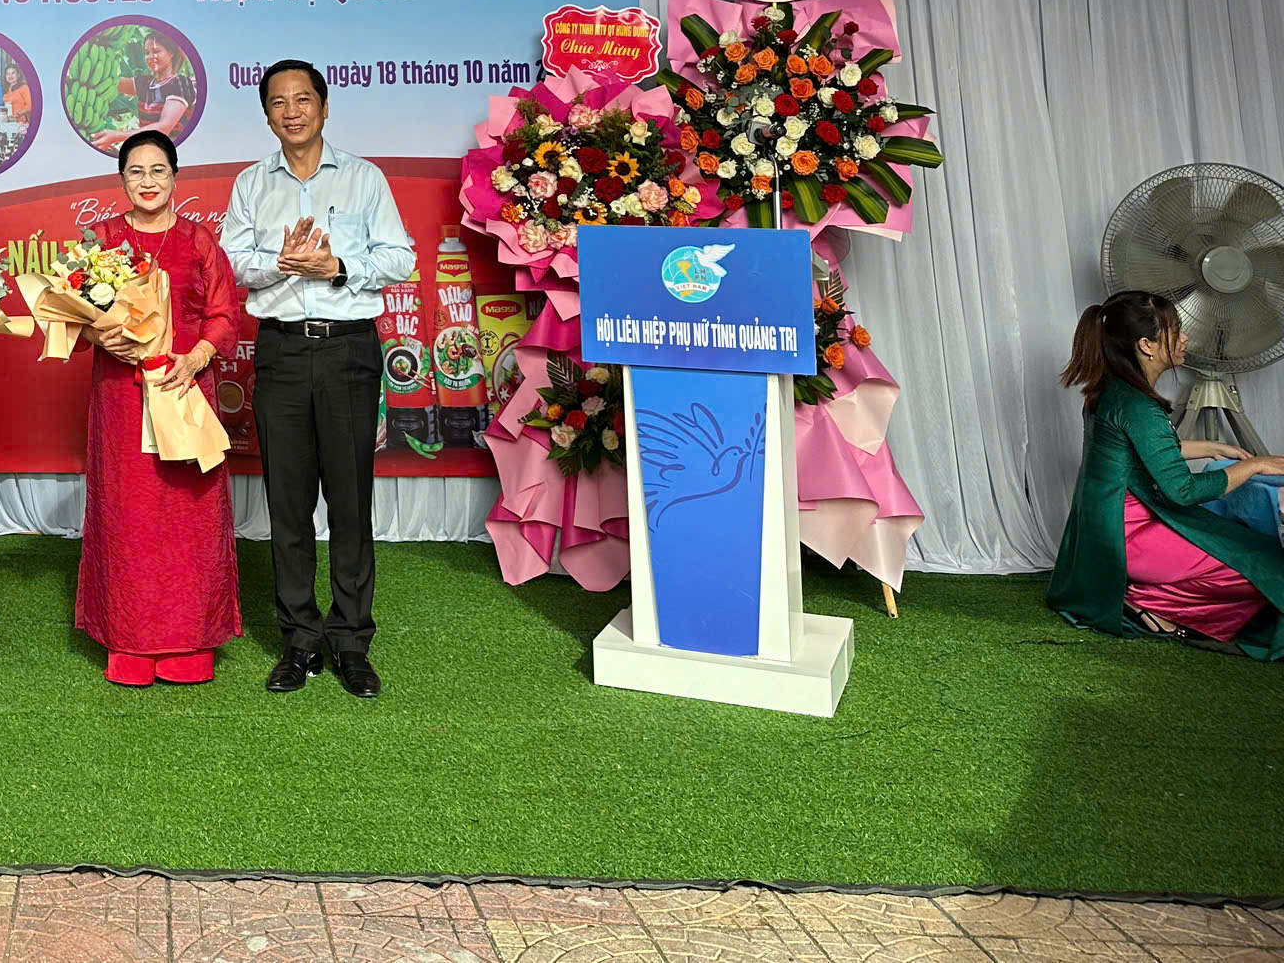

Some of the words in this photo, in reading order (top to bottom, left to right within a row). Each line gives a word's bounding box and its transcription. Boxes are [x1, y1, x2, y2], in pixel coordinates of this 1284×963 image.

[560, 38, 595, 54] Chúc
[597, 40, 641, 61] Mừng
[229, 61, 270, 89] Quả
[326, 60, 372, 88] ngày
[376, 60, 397, 85] 18
[402, 59, 459, 87] tháng
[463, 59, 483, 84] 10
[488, 59, 531, 83] năm
[7, 228, 58, 277] NẤU
[439, 263, 468, 271] Maggi
[448, 302, 473, 324] HÀO
[485, 305, 517, 314] Maggi
[596, 312, 615, 347] HỘI
[616, 313, 641, 344] LIÊN
[642, 315, 667, 350] HIỆP
[669, 320, 691, 352] PHỤ
[693, 317, 710, 348] NỮ
[711, 315, 737, 349] TỈNH
[738, 316, 778, 352] QUẢNG
[778, 325, 798, 357] TRỊ
